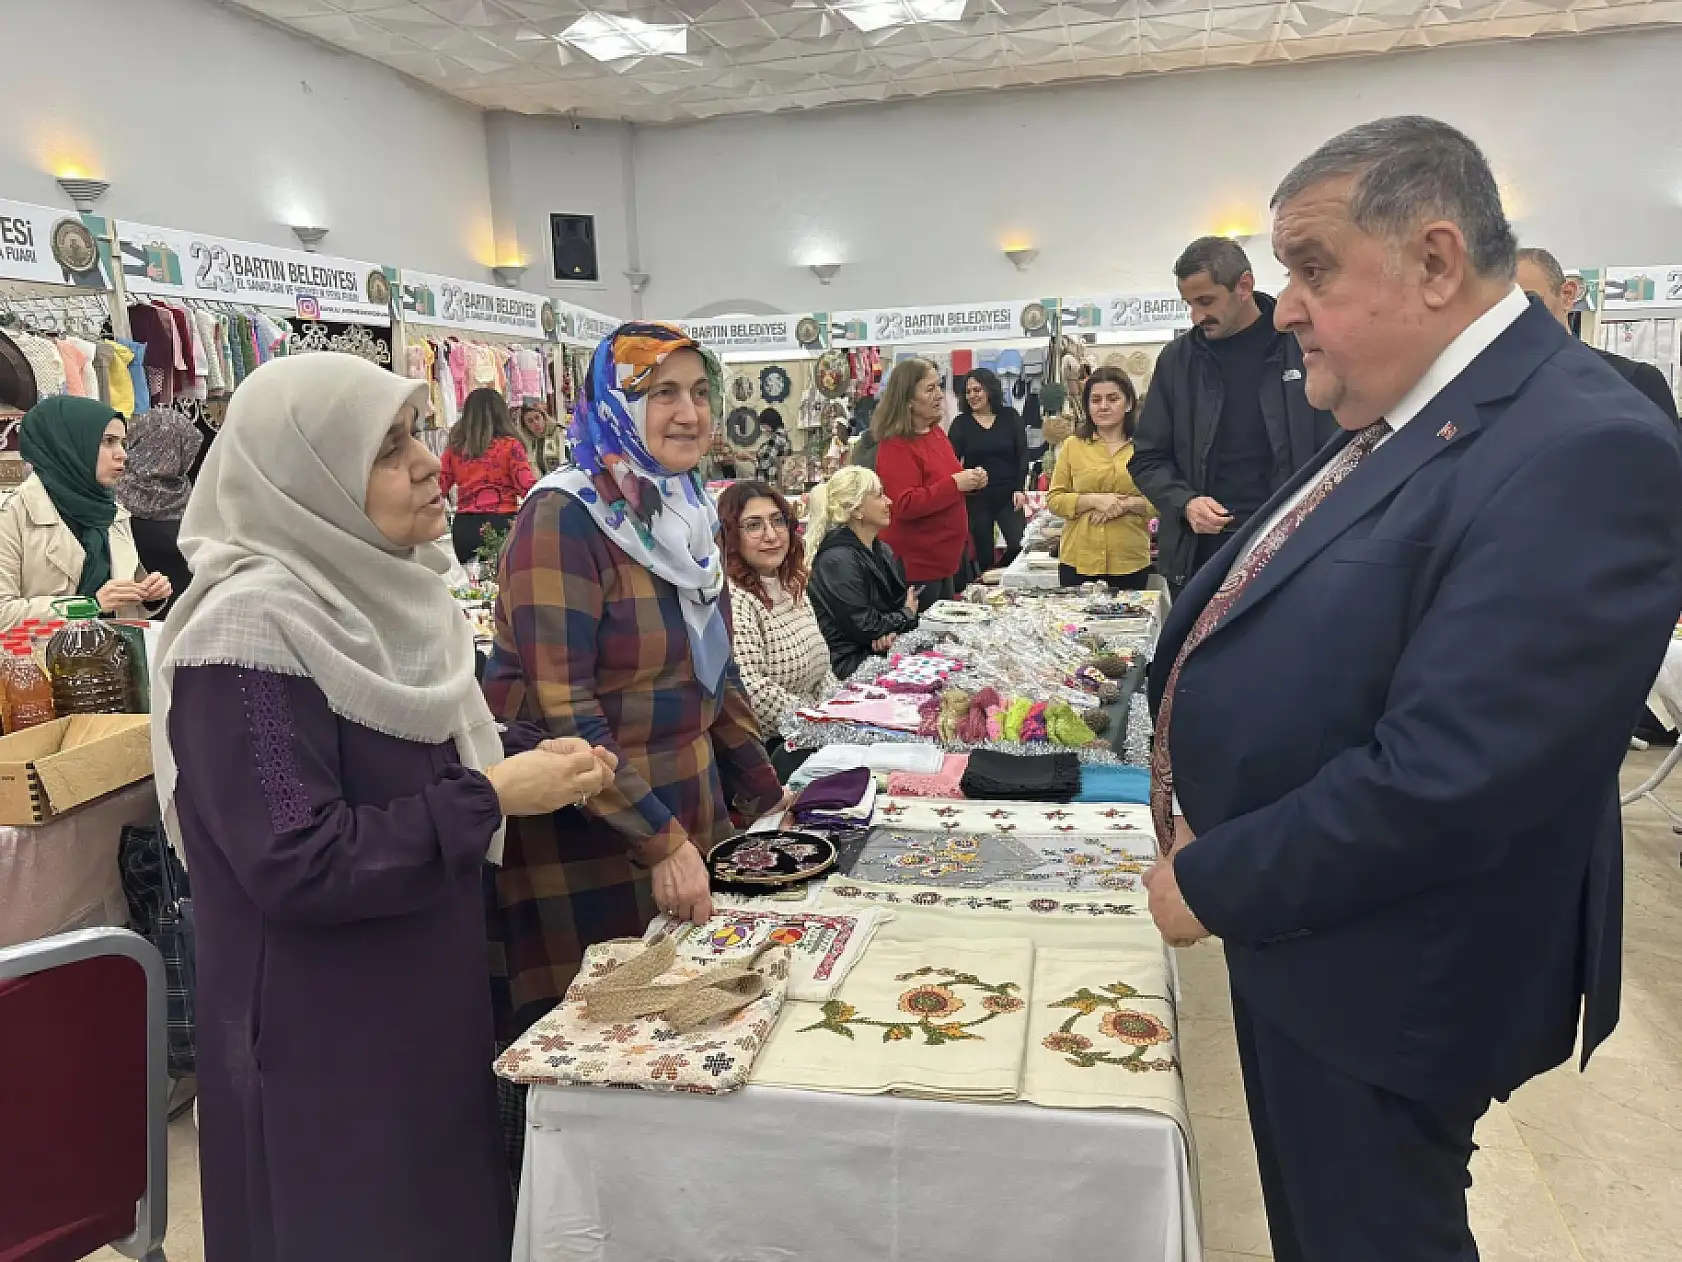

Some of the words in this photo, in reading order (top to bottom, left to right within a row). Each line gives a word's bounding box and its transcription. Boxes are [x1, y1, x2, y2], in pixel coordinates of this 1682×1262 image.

[0, 216, 33, 247] ESİ
[190, 242, 237, 294] 23
[232, 253, 284, 282] BARTIN
[287, 262, 358, 292] BELEDİYESİ
[875, 312, 905, 341] 23
[904, 312, 945, 329] BARTIN
[947, 308, 1011, 326] BELEDİYESİ
[1110, 298, 1141, 326] 23
[691, 324, 728, 339] BARTIN
[730, 321, 787, 338] BELEDİYESİ
